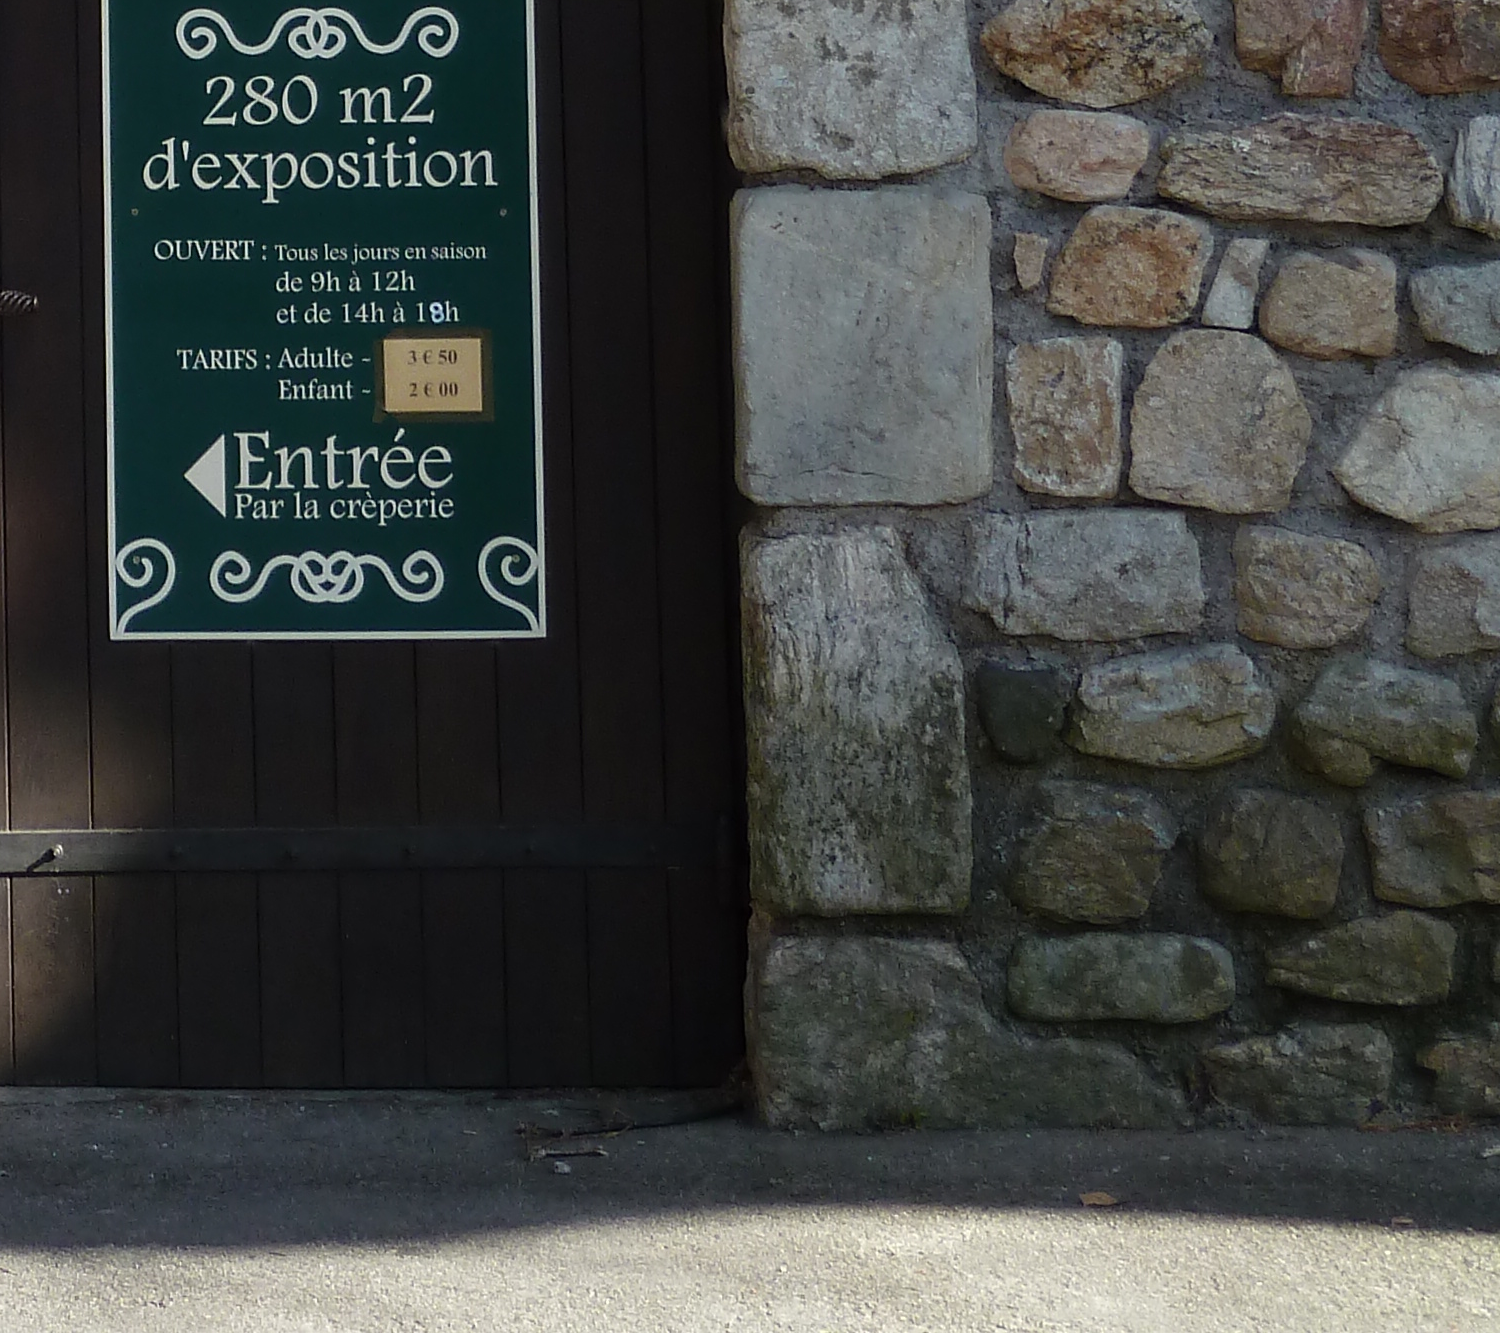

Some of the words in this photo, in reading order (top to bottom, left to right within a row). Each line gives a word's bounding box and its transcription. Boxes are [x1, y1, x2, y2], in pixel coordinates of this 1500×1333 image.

[202, 74, 318, 126] 280
[339, 74, 435, 124] m2
[143, 136, 498, 204] d'exposition
[153, 240, 254, 261] OUVERT
[274, 245, 318, 261] Tous
[324, 244, 348, 261] les
[351, 245, 399, 265] jours
[405, 247, 426, 260] en
[431, 242, 486, 260] saison
[276, 272, 303, 292] de
[311, 272, 340, 292] 9h
[349, 271, 361, 292] à
[373, 271, 415, 291] 12h
[276, 305, 296, 324] et
[304, 303, 331, 324] de
[342, 303, 384, 323] 14h
[393, 302, 405, 323] à
[417, 301, 459, 323] 18h
[177, 349, 257, 370] TARIFS
[278, 347, 353, 369] Adulte
[407, 350, 417, 364] 3
[438, 350, 457, 364] 50
[278, 379, 353, 401] Enfant
[409, 383, 418, 397] 2
[439, 382, 458, 397] 00
[233, 429, 454, 490] Entrée
[234, 493, 284, 519] Par
[294, 493, 320, 519] la
[330, 491, 455, 526] crèperie
